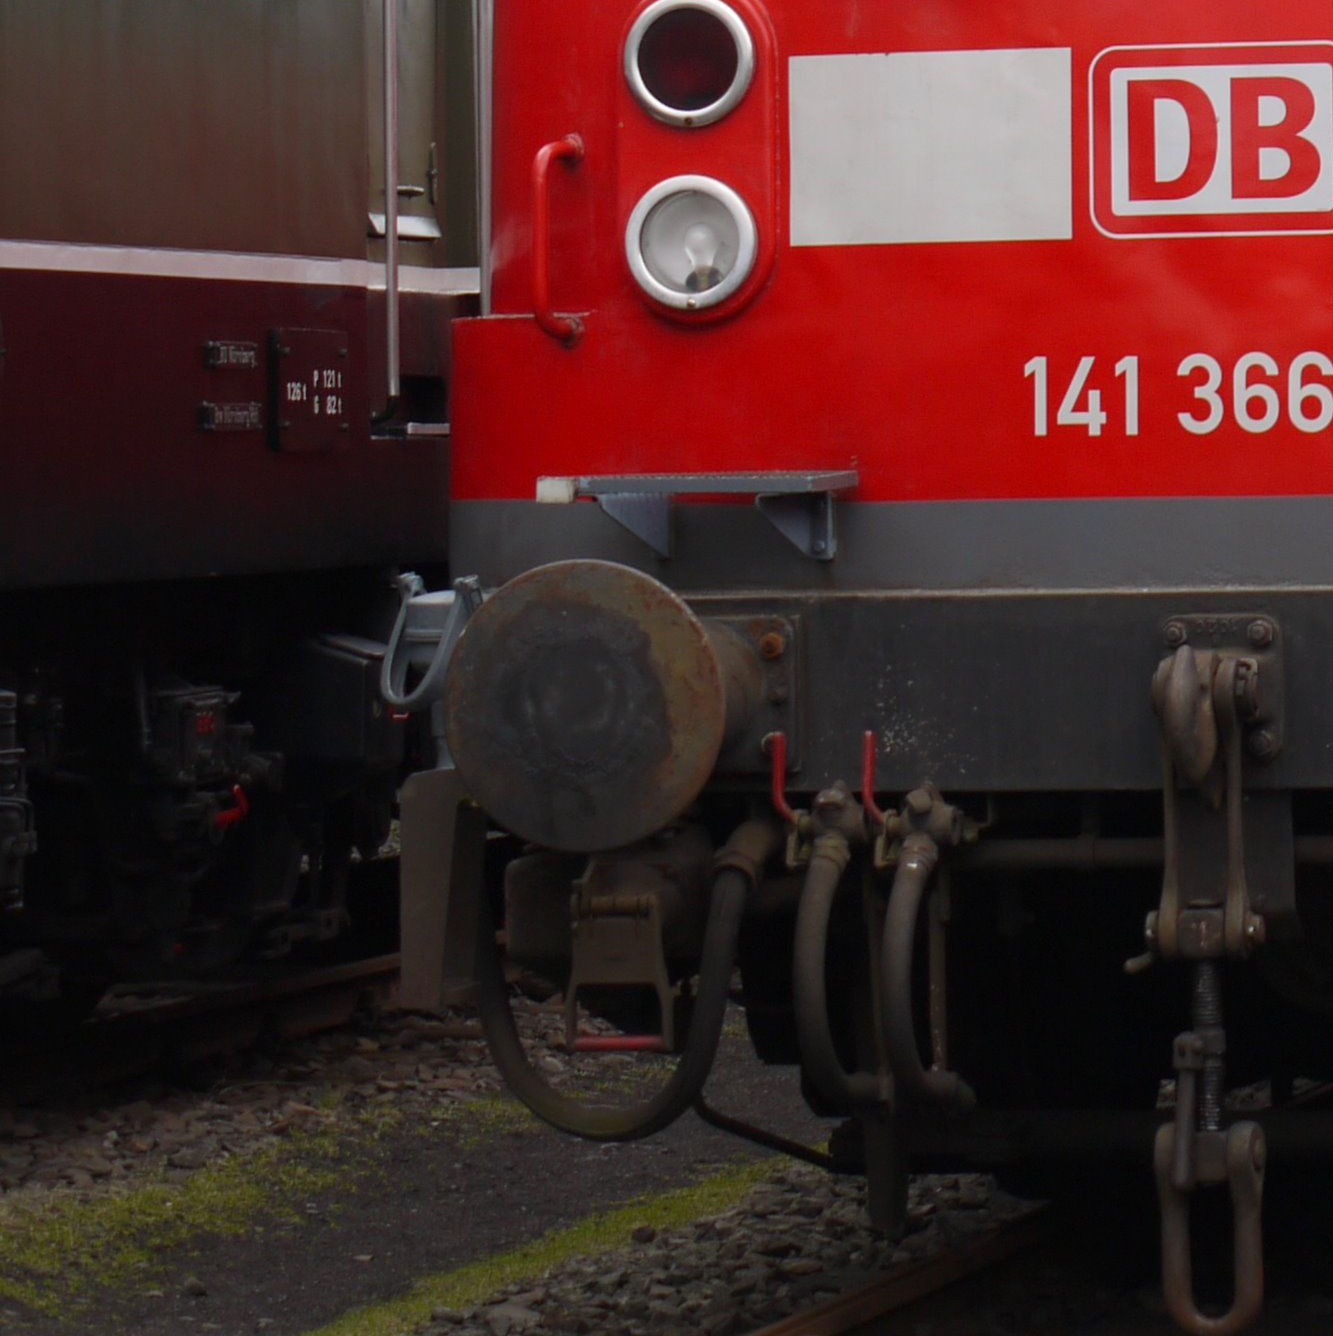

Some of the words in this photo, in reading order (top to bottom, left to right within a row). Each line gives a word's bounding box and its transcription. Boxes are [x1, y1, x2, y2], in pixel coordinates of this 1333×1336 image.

[1127, 75, 1322, 202] DB
[323, 369, 336, 388] 121
[1023, 355, 1139, 437] 141
